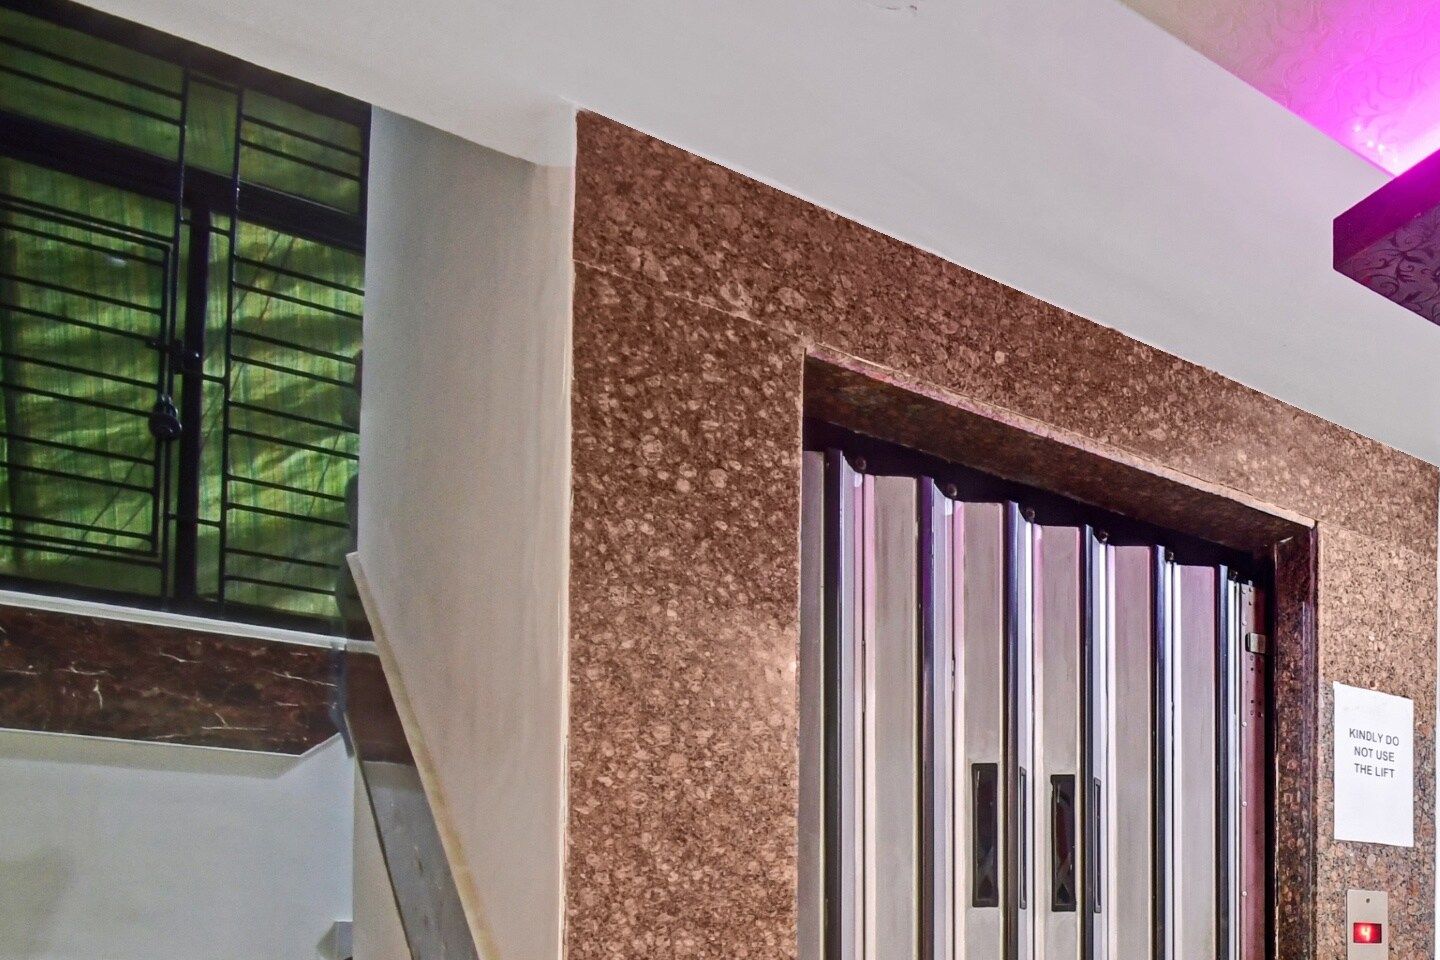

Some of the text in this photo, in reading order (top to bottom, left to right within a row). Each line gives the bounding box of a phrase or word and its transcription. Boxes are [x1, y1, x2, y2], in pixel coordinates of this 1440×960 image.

[1349, 727, 1400, 747] KINDLY DO
[1354, 746, 1395, 763] NOT USE
[1354, 762, 1396, 779] THE LIFT
